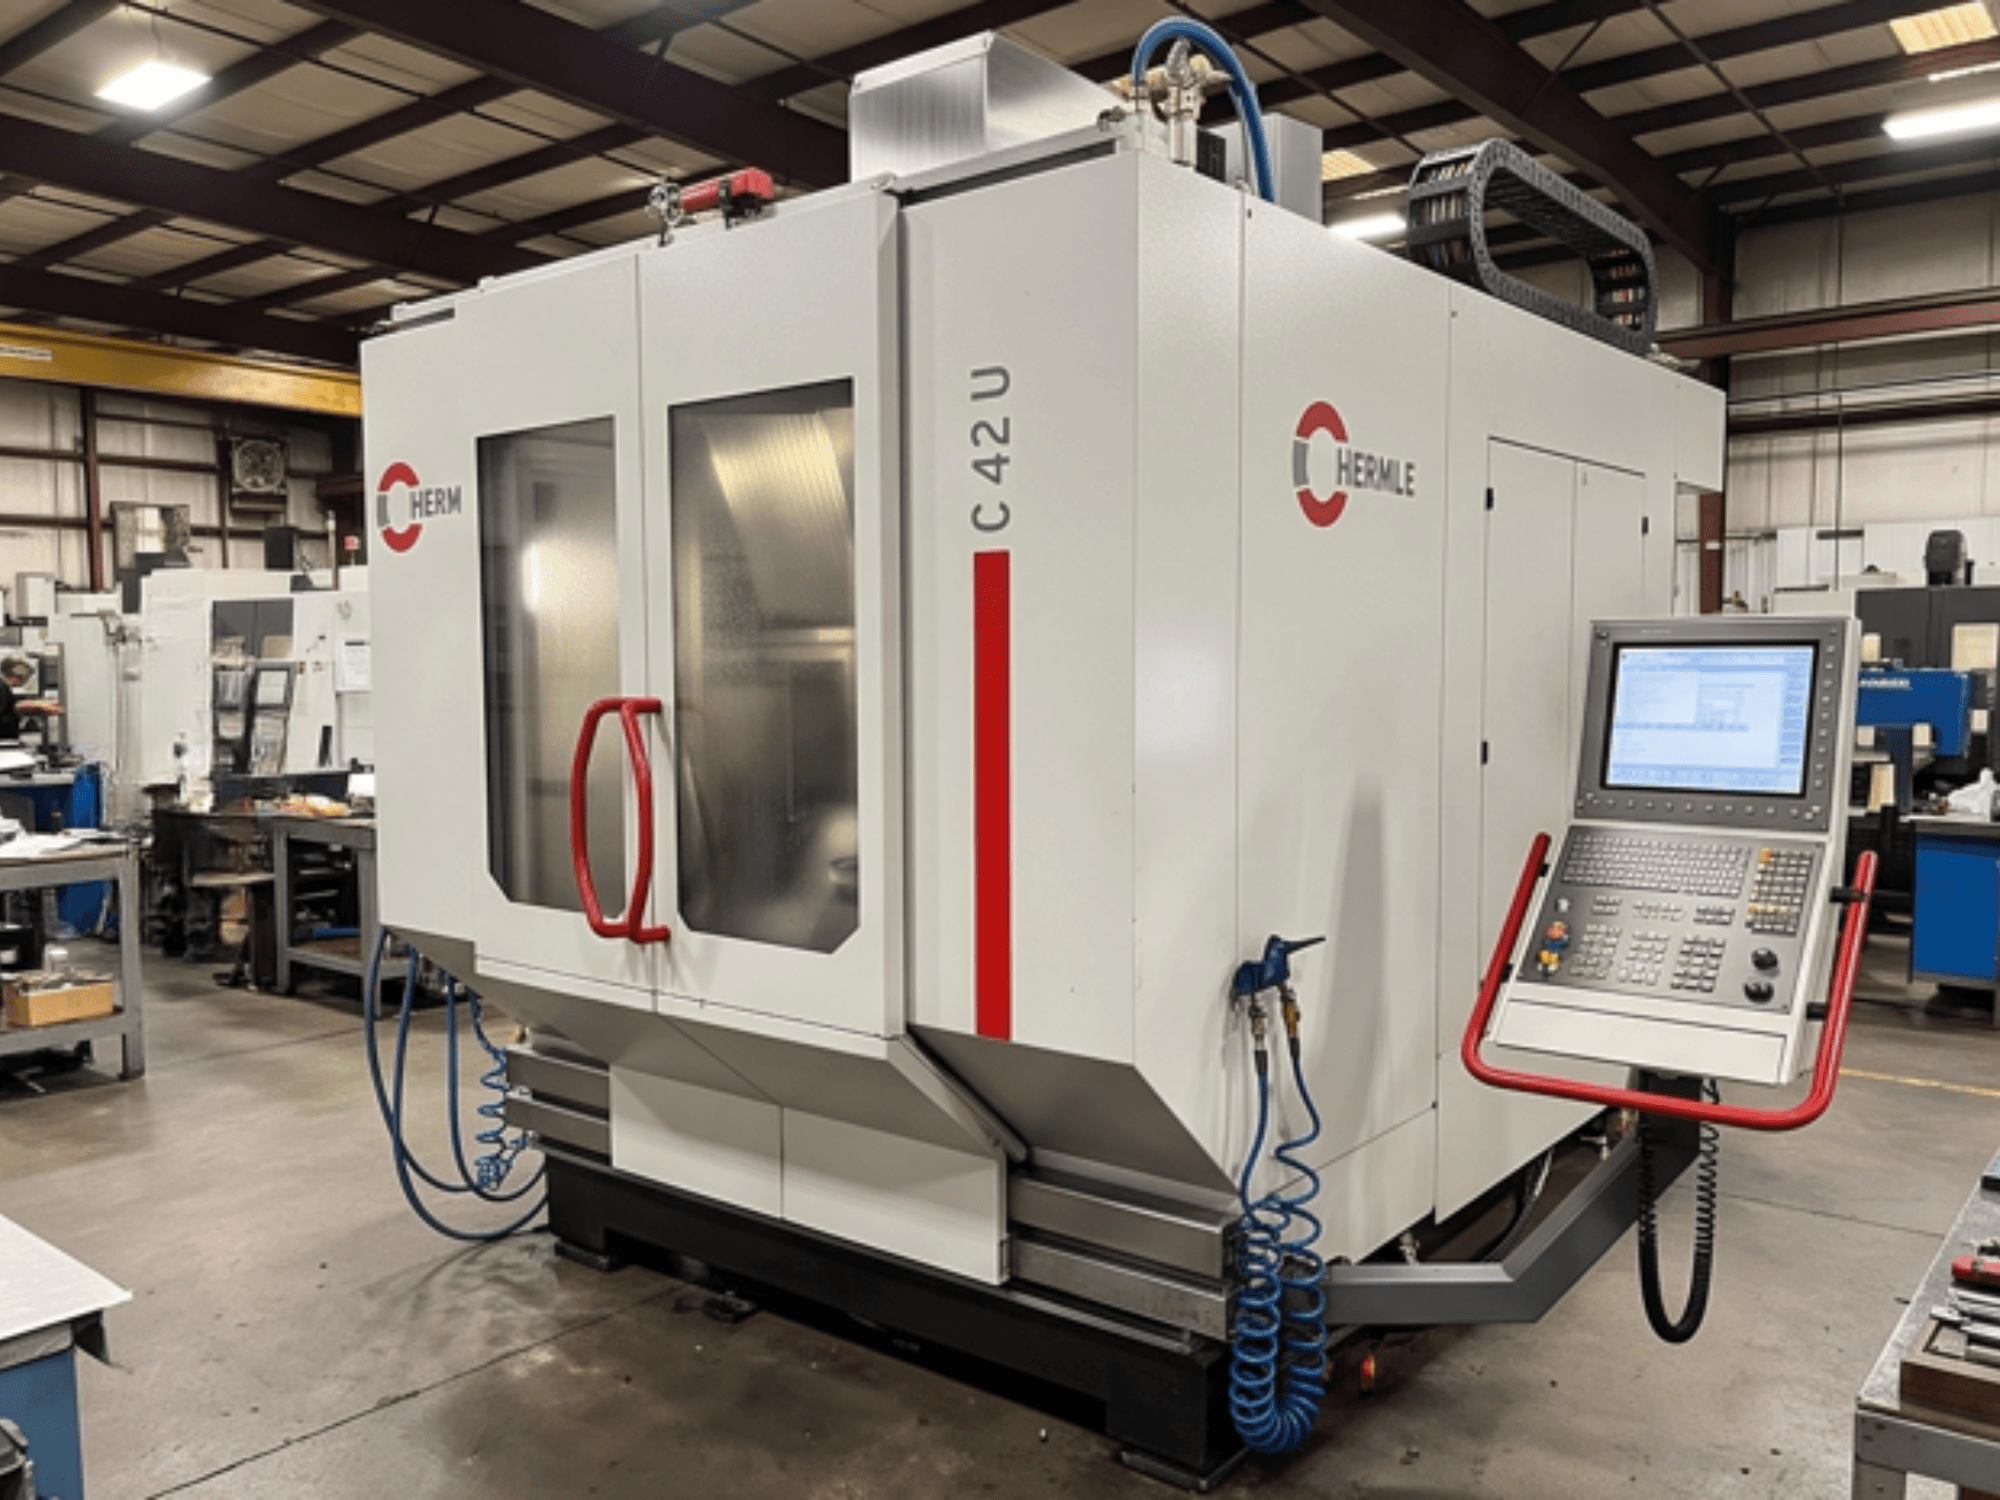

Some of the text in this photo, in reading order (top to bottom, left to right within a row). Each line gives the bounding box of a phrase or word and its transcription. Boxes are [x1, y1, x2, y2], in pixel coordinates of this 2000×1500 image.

[971, 366, 1010, 532] C 42 U
[1337, 448, 1415, 497] HERMLE
[409, 485, 462, 519] HERM
